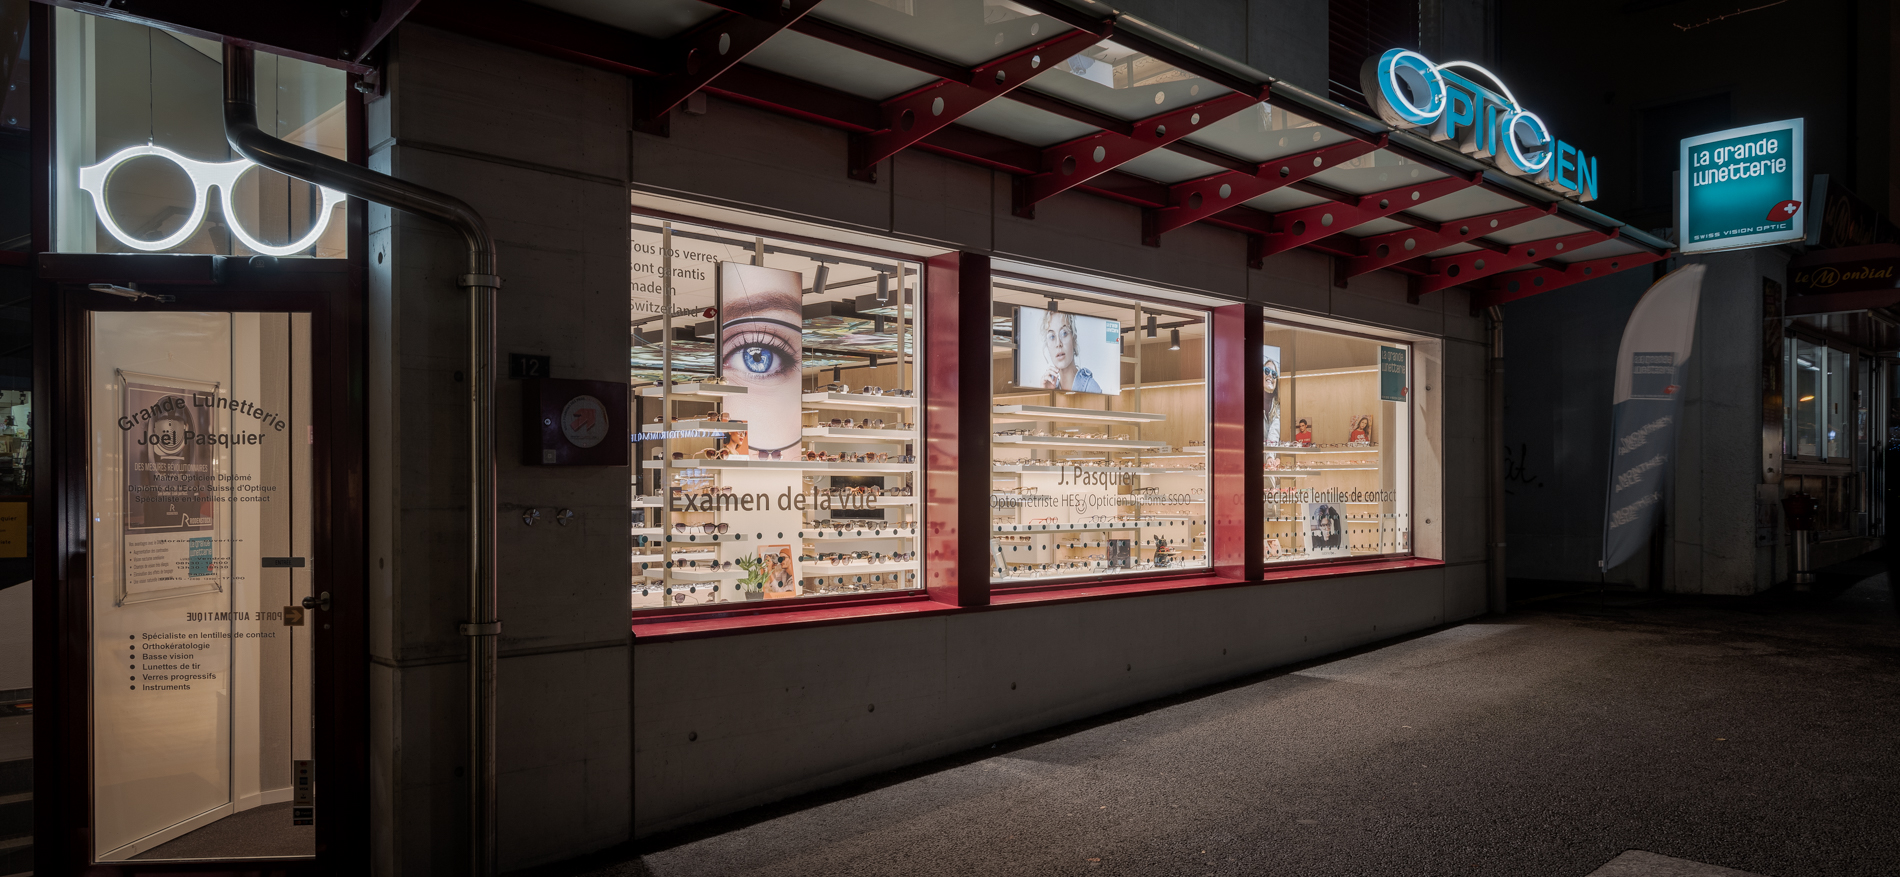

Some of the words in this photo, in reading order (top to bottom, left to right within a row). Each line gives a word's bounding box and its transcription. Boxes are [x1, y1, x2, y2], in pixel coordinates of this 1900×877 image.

[1377, 48, 1598, 200] OPTICIEN
[1714, 138, 1778, 165] grande
[1694, 232, 1720, 240] SWISS
[1723, 227, 1754, 236] VISION
[1756, 223, 1787, 232] OPTIC
[659, 246, 680, 258] nos
[682, 251, 718, 264] verres
[657, 266, 706, 281] garantis
[521, 358, 539, 376] 12
[118, 396, 186, 432] Grande
[193, 393, 286, 432] Lunetterie
[137, 430, 176, 446] Joël
[184, 430, 266, 449] Pasquier
[134, 463, 145, 471] DES
[145, 463, 167, 472] MESURES
[154, 474, 179, 482] Maître
[181, 474, 215, 483] Opticien
[218, 473, 252, 483] Diplômé
[1057, 466, 1069, 486] J.
[1074, 466, 1137, 490] Pasquier
[128, 485, 162, 493] Diplômé
[236, 484, 277, 493] d'Optique
[1311, 486, 1349, 503] lentilles
[1351, 486, 1362, 503] de
[1364, 488, 1396, 503] contact
[135, 495, 180, 504] Spécialiste
[669, 486, 770, 512] Examen
[778, 486, 806, 511] de
[813, 486, 832, 511] la
[838, 494, 877, 510] vue
[989, 493, 1059, 511] Optométriste
[1061, 494, 1080, 507] HES
[1088, 494, 1128, 510] Opticien
[1130, 493, 1166, 509] Diplômé
[142, 632, 186, 640] Spécialiste
[200, 631, 232, 639] lentilles
[234, 631, 244, 639] de
[142, 642, 210, 651] Orthokératologie
[192, 662, 201, 670] tir
[142, 673, 169, 681] Verres
[170, 672, 217, 682] progressifs
[142, 683, 191, 691] Instruments
